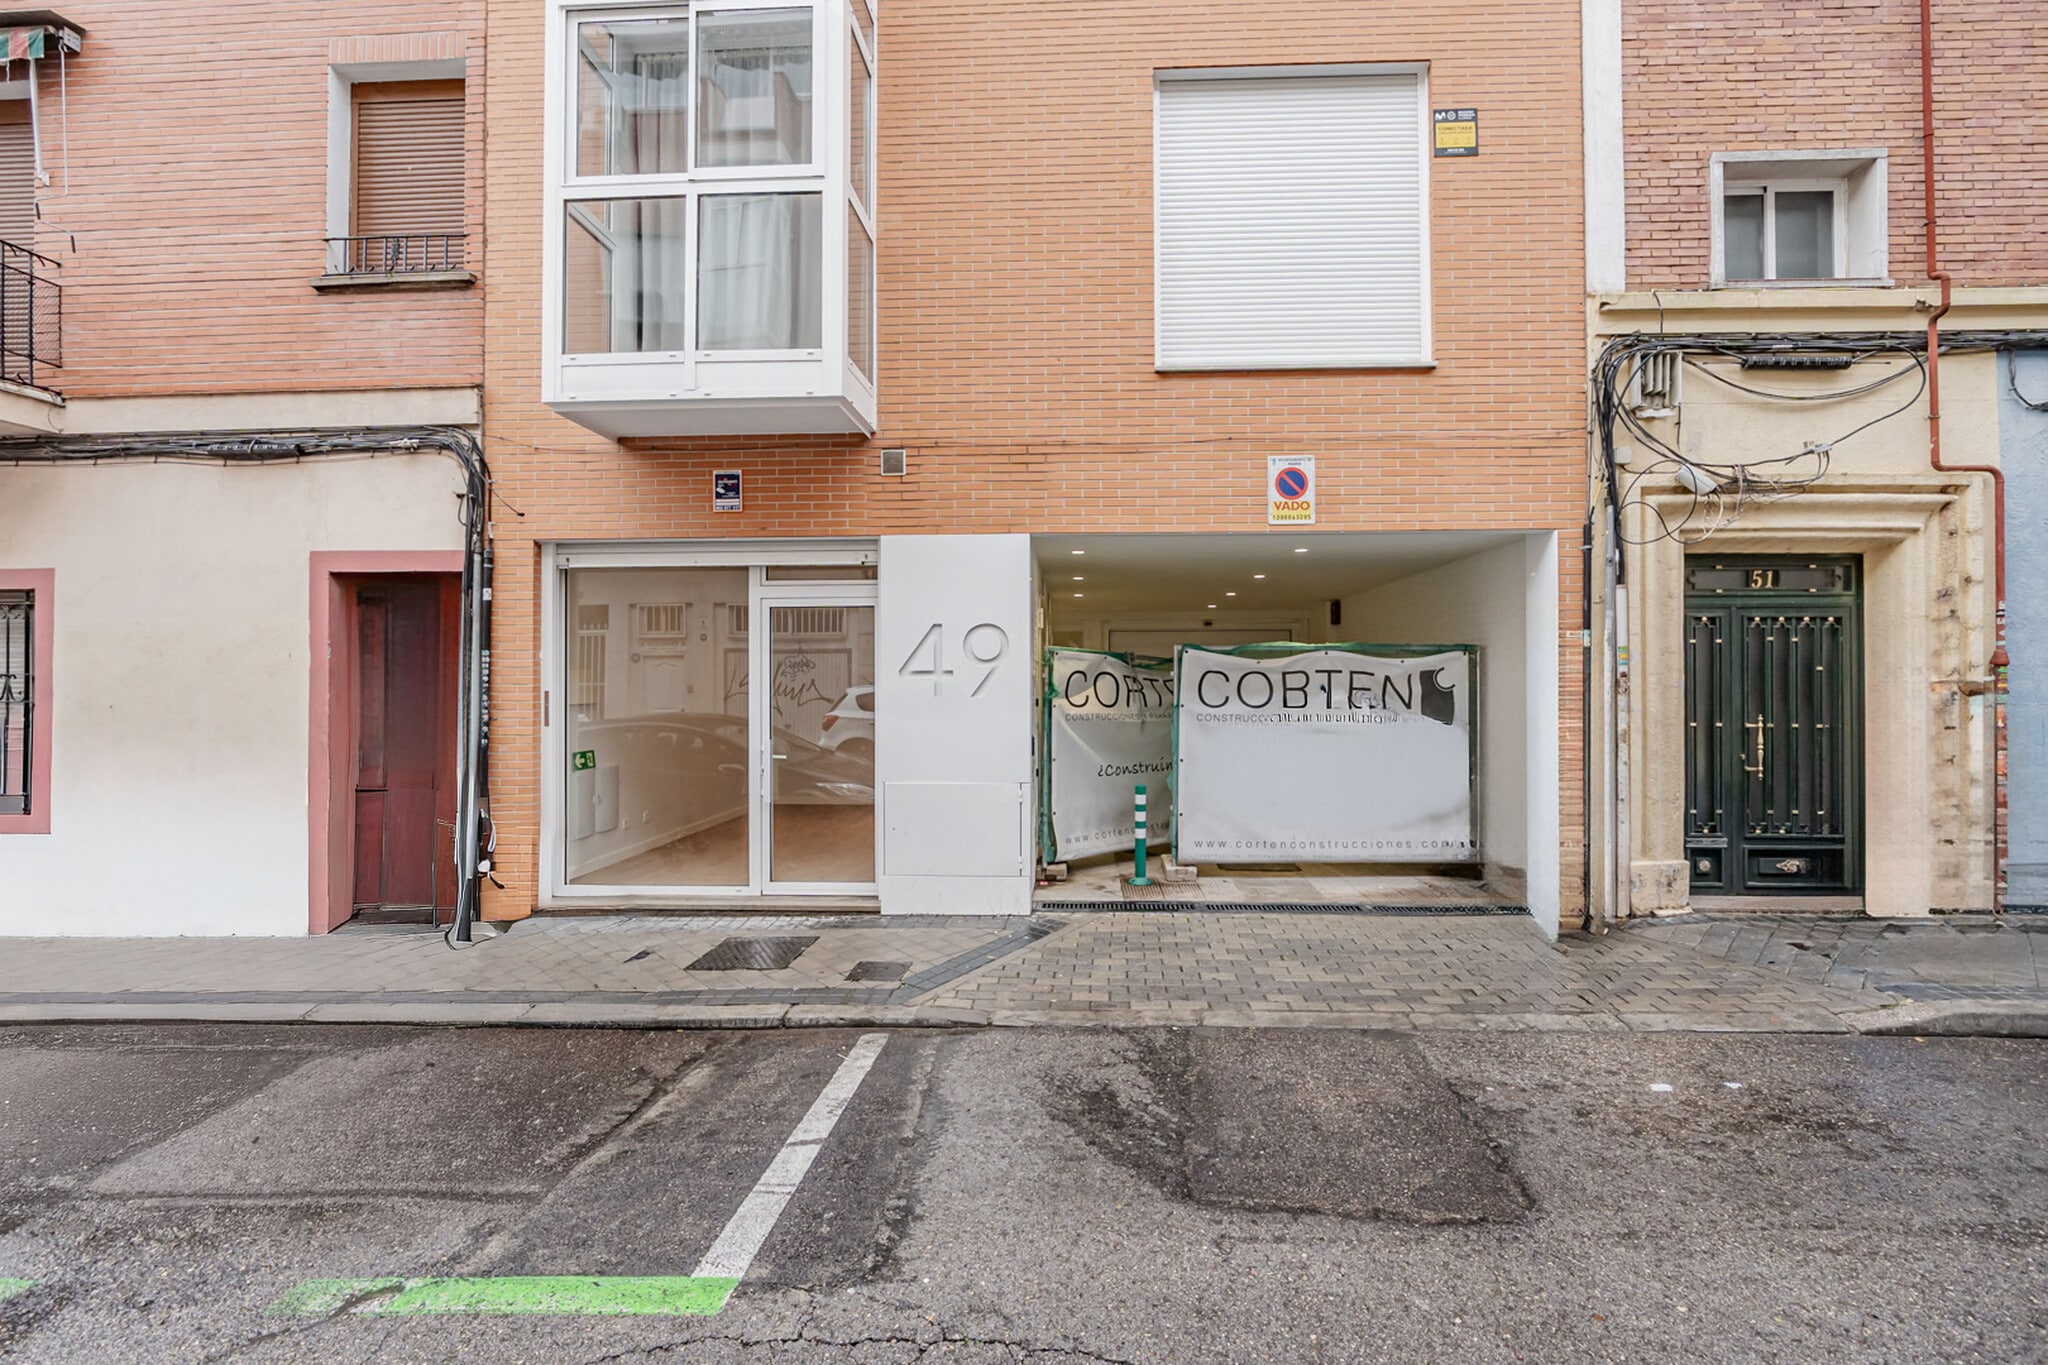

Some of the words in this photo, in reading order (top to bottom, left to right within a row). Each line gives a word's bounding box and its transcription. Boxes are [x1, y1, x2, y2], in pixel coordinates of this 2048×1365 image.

[1273, 501, 1311, 510] VADO
[1751, 570, 1774, 589] 51
[898, 622, 1010, 698] 49
